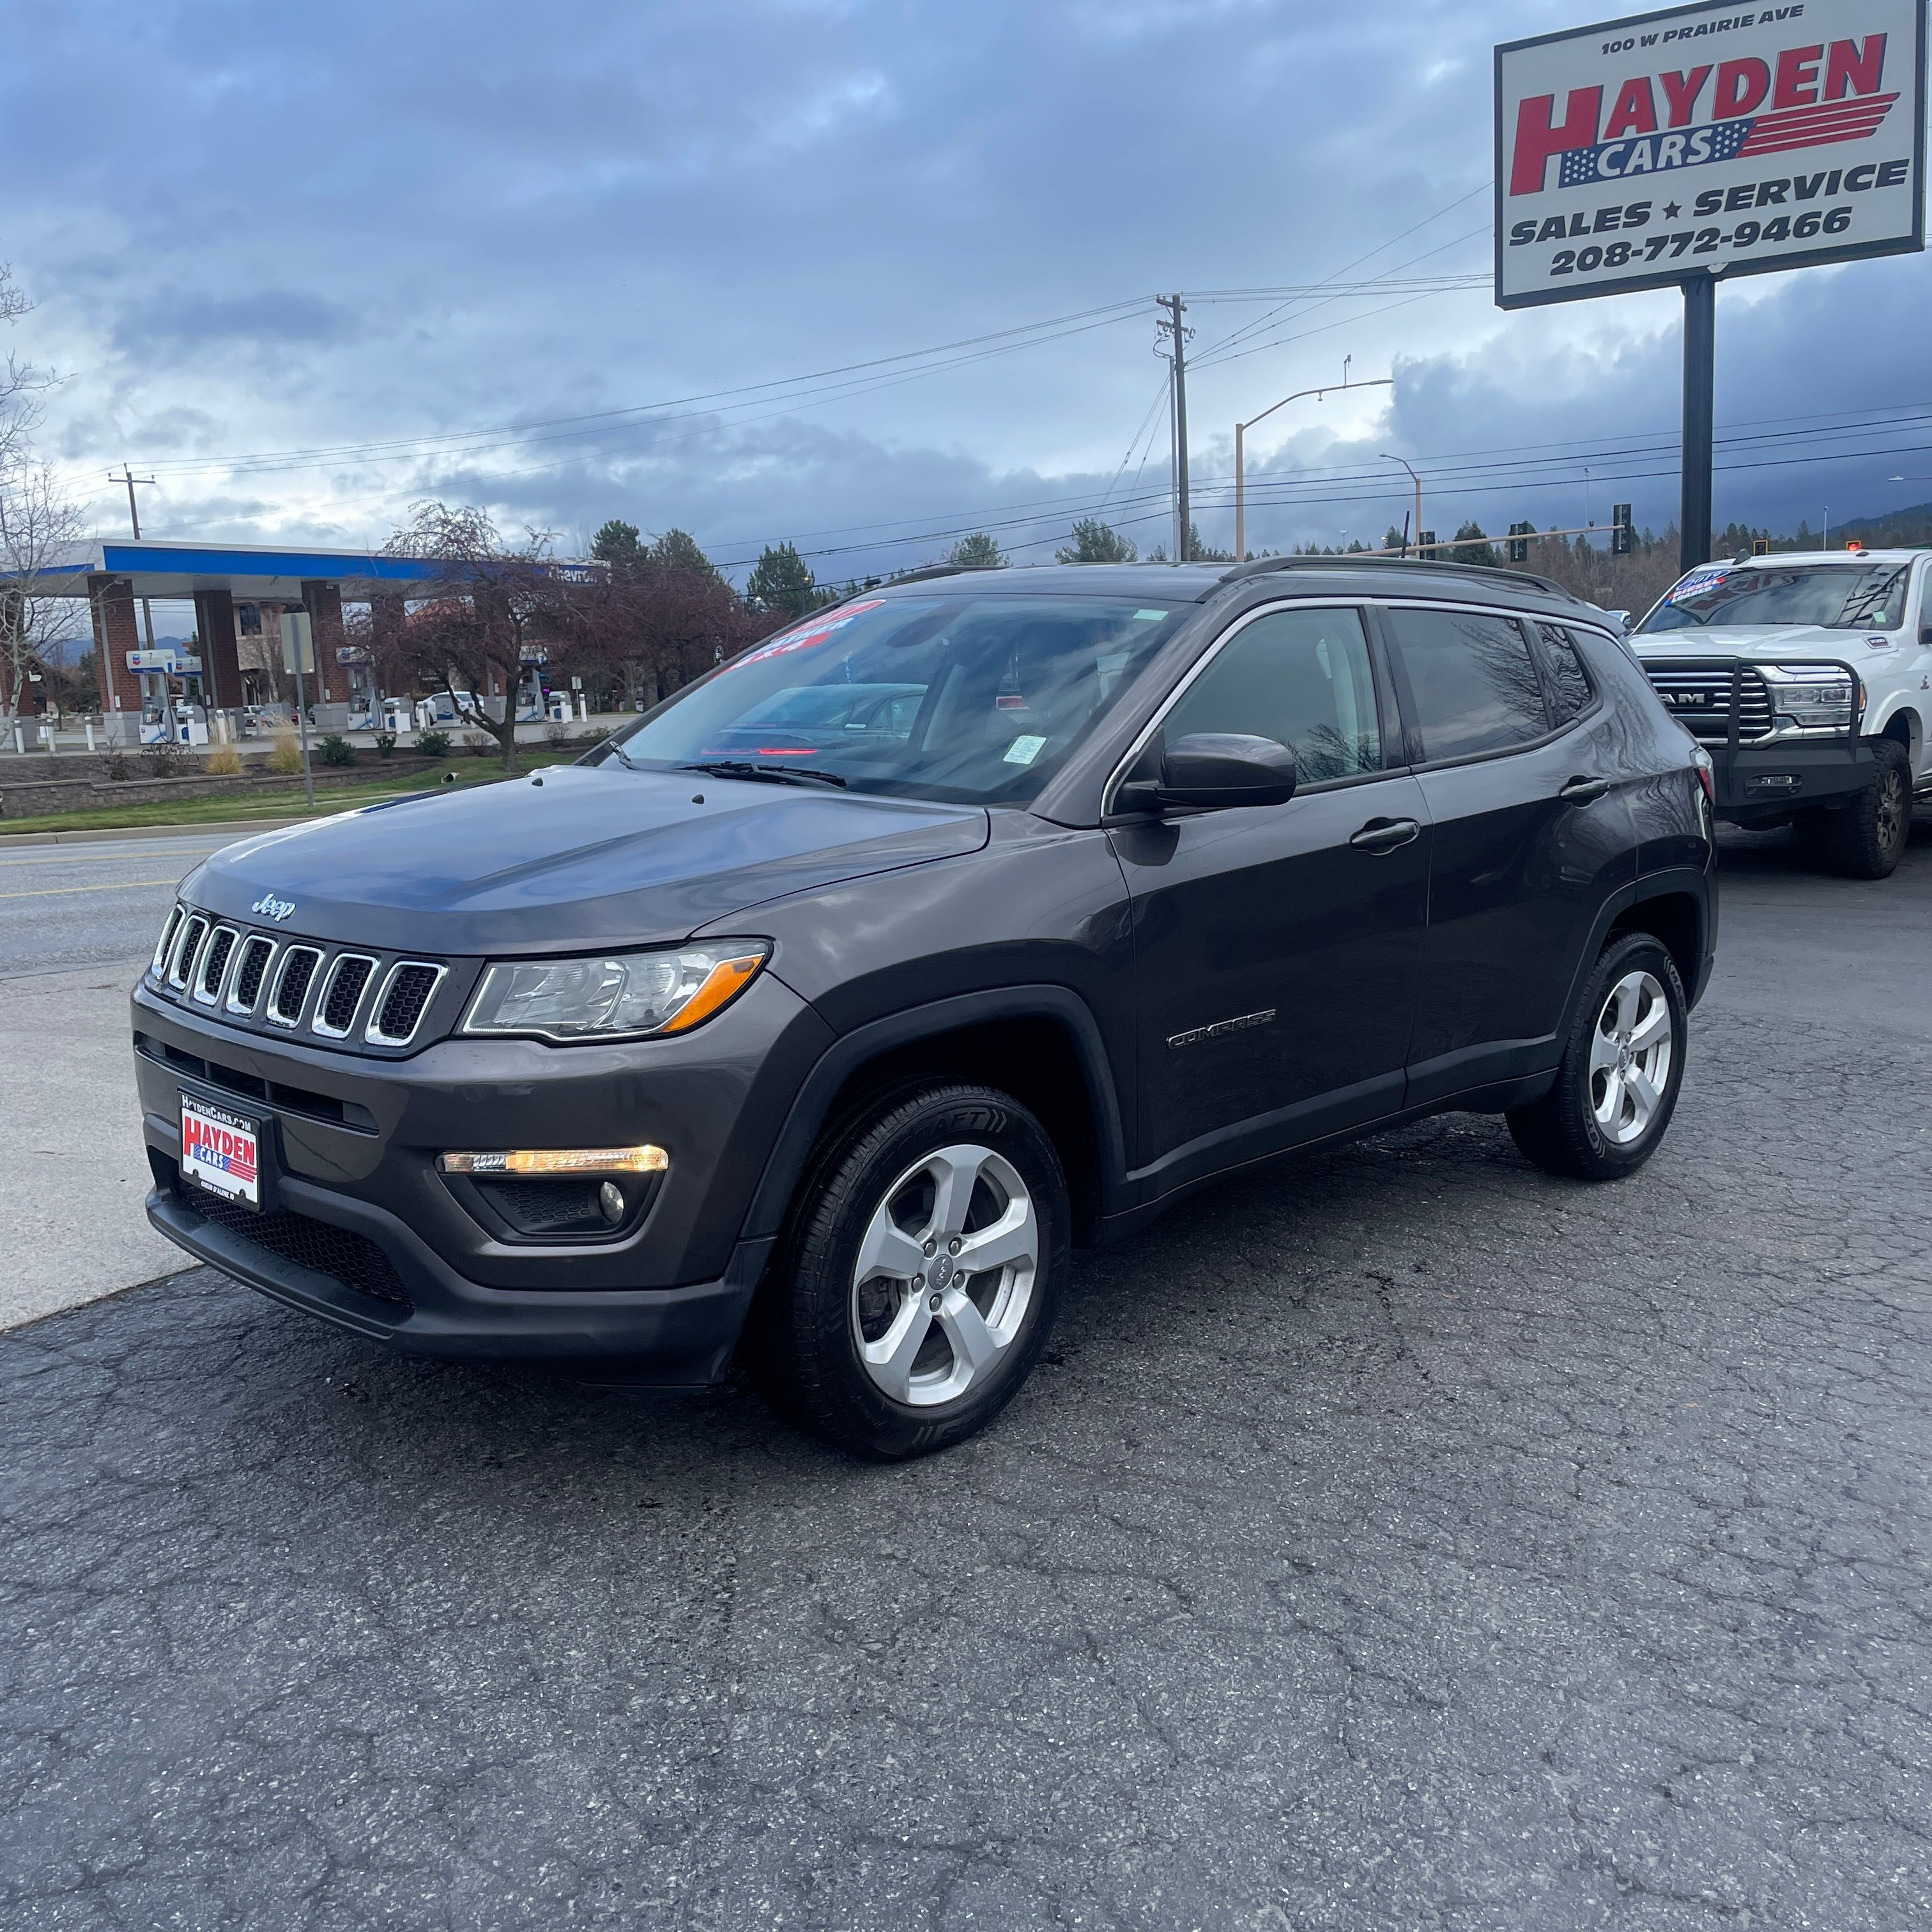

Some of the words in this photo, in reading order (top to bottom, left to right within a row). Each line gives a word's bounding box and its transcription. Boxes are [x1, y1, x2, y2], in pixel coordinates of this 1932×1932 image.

[1602, 38, 1634, 54] 100
[1639, 33, 1660, 48] W
[1662, 13, 1755, 43] PRAIRIE
[1758, 4, 1804, 25] AVE
[1509, 33, 1888, 197] HAYDEN
[1597, 128, 1713, 178] CARS
[1509, 201, 1653, 247] SALES
[1693, 158, 1910, 217] SERVICE
[1550, 206, 1853, 277] 208-772-9466
[1671, 585, 1713, 604] LOADED
[1658, 693, 1705, 704] AM
[251, 893, 296, 922] Jeep
[1166, 1008, 1276, 1050] COMPASS
[183, 1116, 255, 1166] HAYDEN
[199, 1147, 224, 1168] CARS
